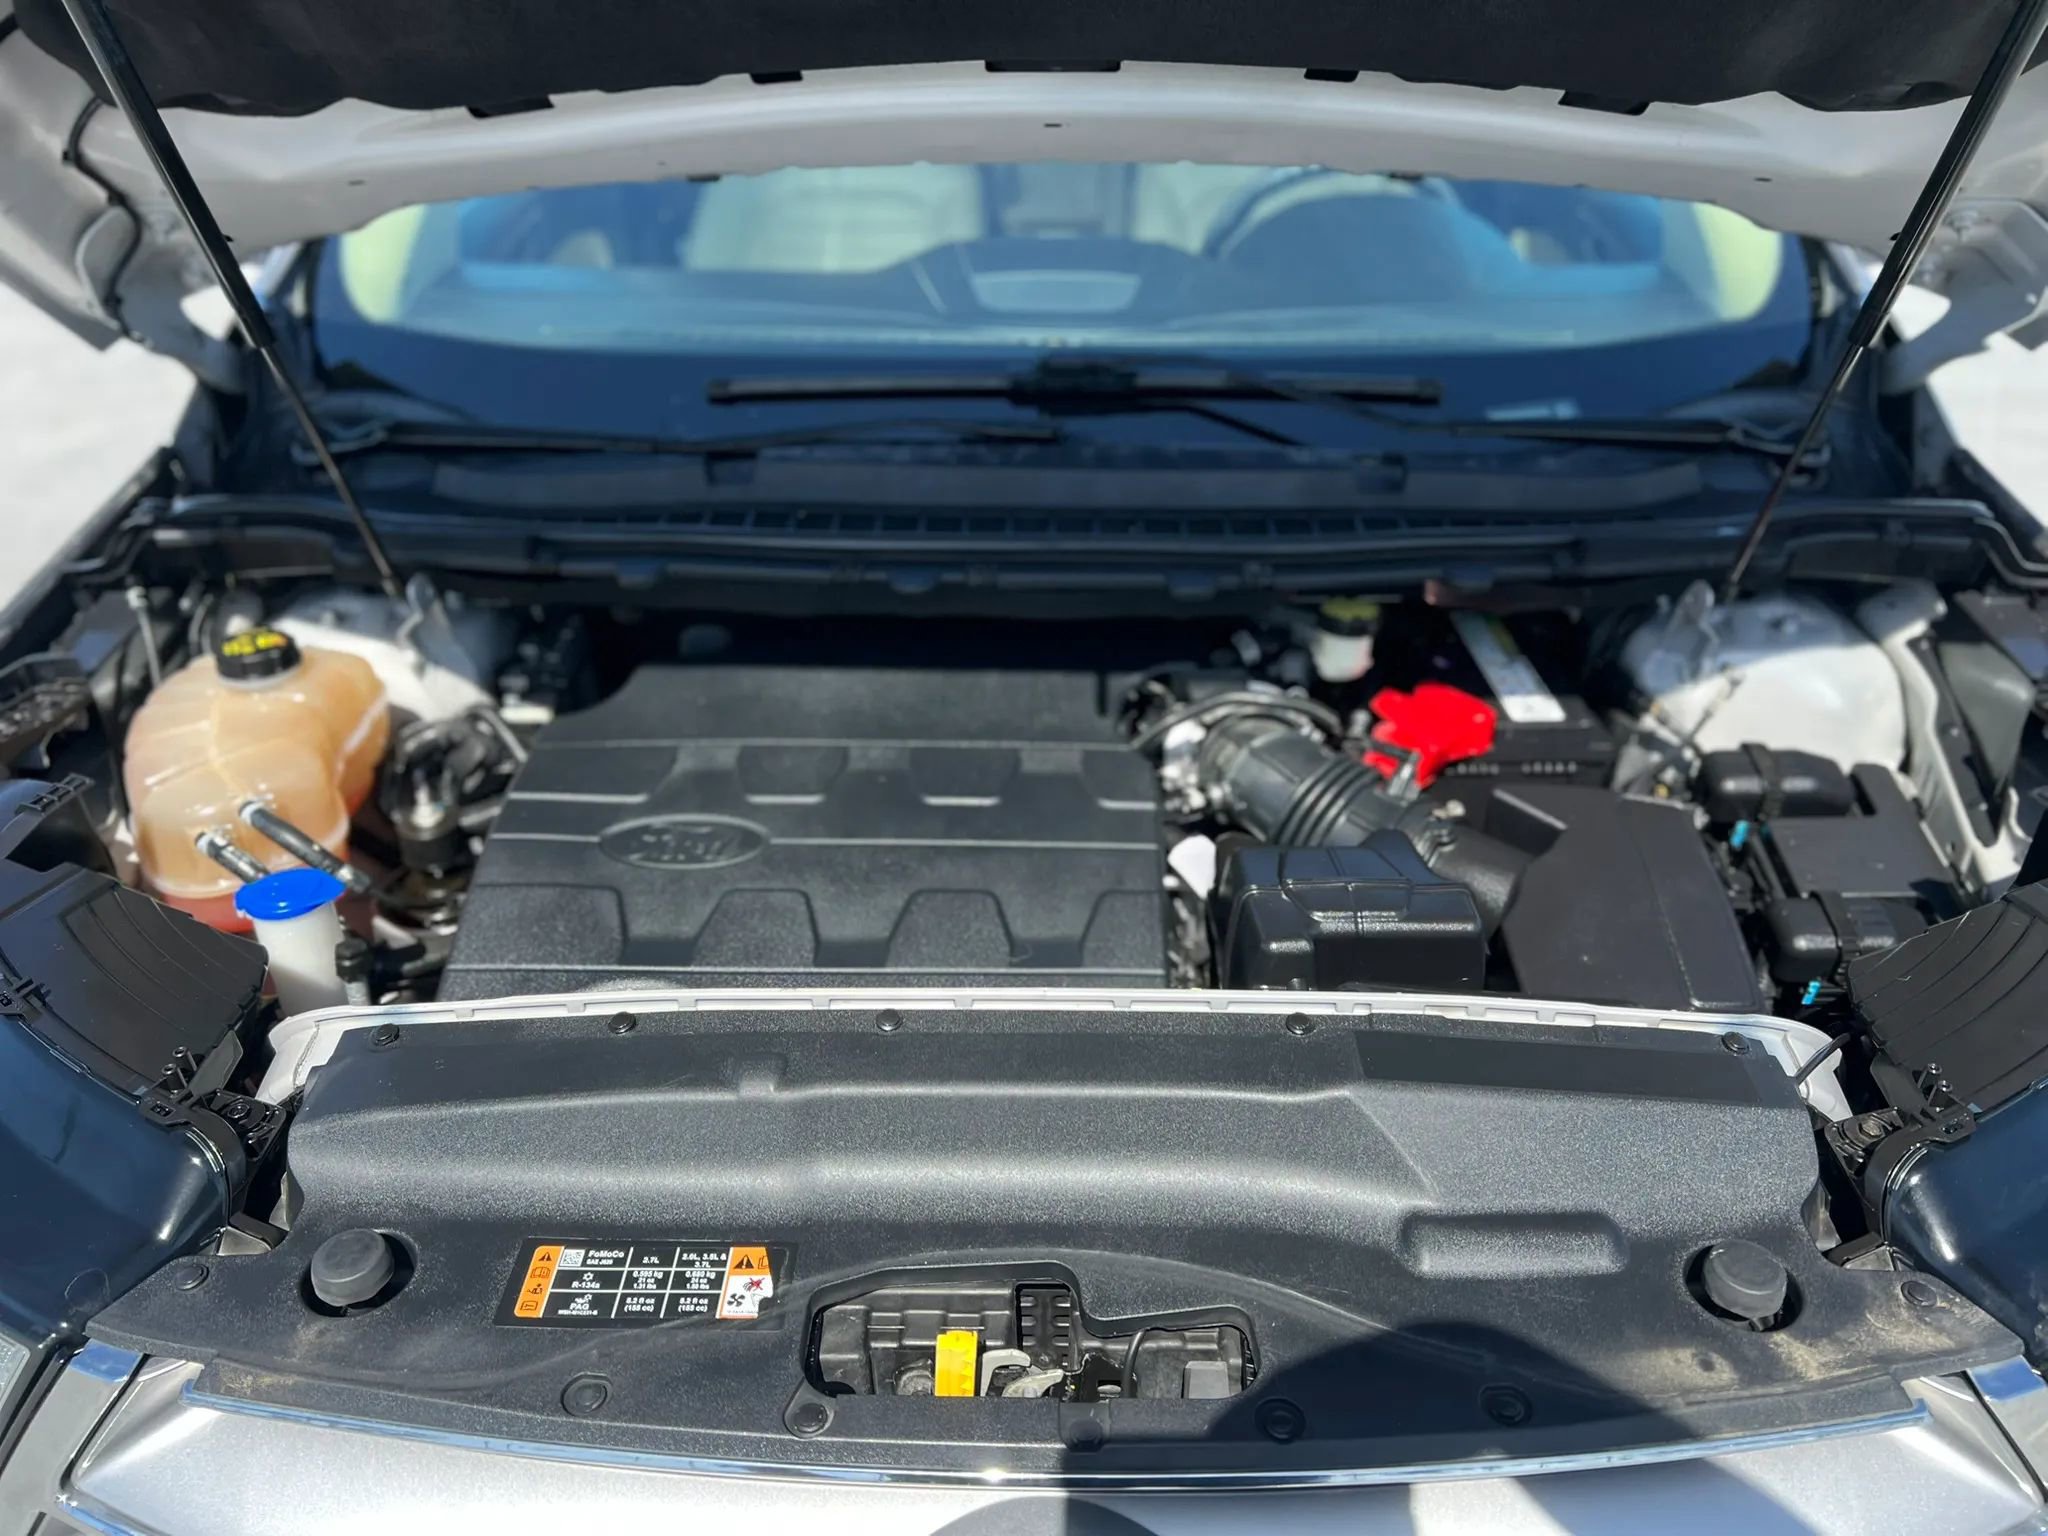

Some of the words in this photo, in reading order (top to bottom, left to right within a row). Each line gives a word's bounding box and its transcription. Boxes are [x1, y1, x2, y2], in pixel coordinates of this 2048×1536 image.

[588, 1250, 625, 1258] FoMoCo
[653, 1270, 664, 1279] kg
[706, 1270, 716, 1279] kg
[571, 1281, 601, 1289] R-134a
[569, 1302, 590, 1310] PAG
